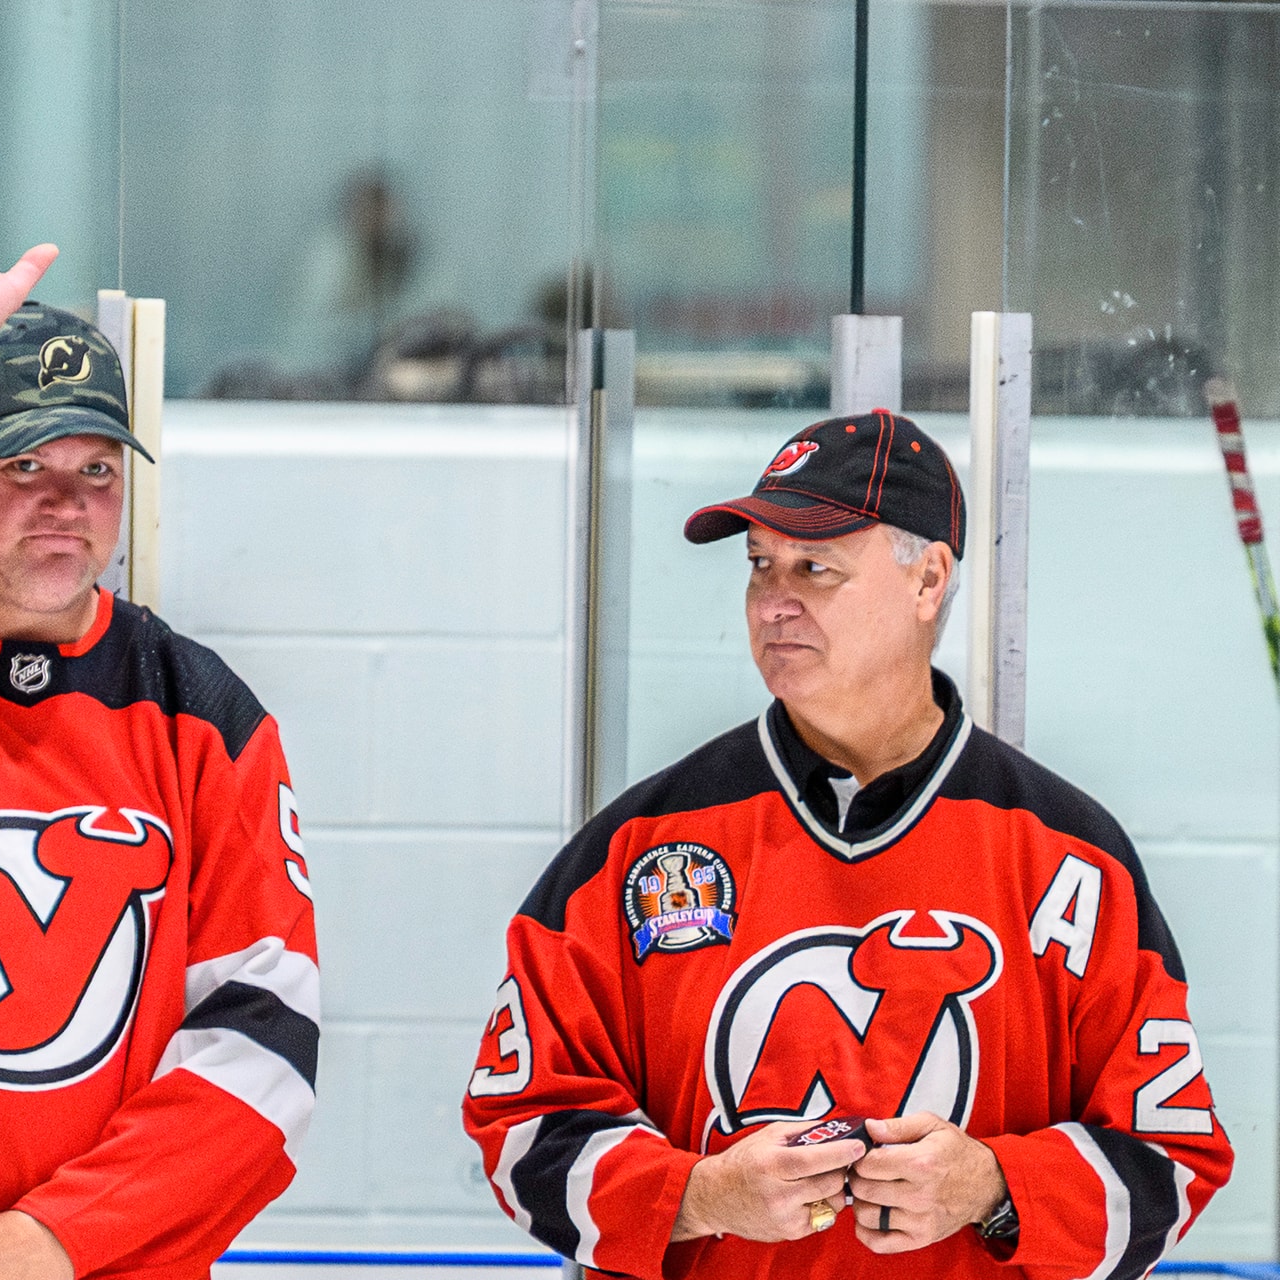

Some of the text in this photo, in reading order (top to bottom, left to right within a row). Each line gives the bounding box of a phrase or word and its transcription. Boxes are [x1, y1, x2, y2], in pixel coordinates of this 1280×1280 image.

[19, 663, 41, 683] NHL
[638, 864, 716, 895] 19 95
[649, 909, 694, 939] STANLEY
[693, 908, 715, 927] CUP
[1028, 852, 1103, 980] A
[467, 974, 533, 1099] 3
